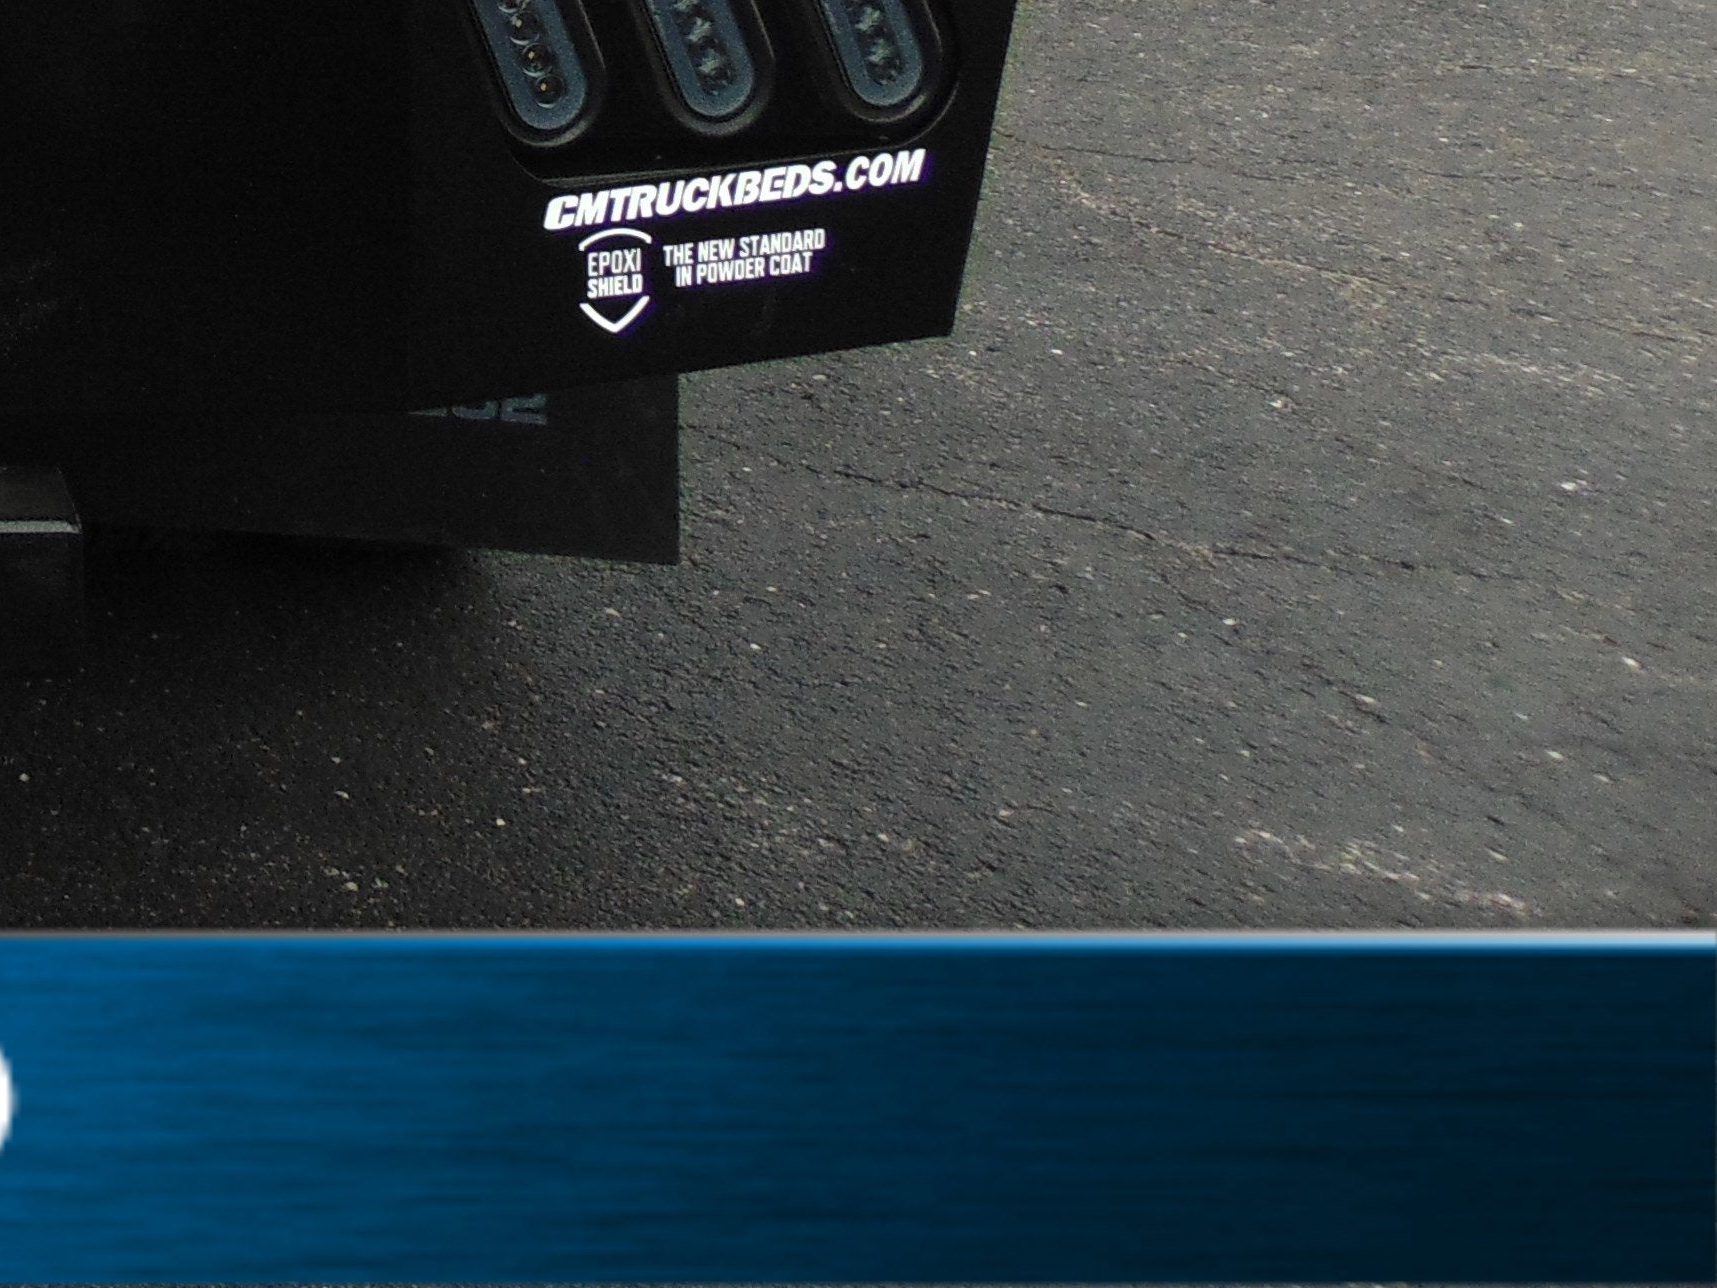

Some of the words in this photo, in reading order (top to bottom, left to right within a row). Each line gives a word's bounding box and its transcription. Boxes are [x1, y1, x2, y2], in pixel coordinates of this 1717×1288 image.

[543, 148, 927, 231] CMTRUCKBEDS.COM
[587, 247, 642, 277] EPOXI
[663, 242, 694, 267] THE
[697, 238, 735, 263] NEW
[739, 228, 826, 258] STANDARD
[587, 273, 643, 299] SHIELD
[675, 264, 692, 288] IN
[696, 256, 765, 286] POWDER
[769, 250, 814, 277] COAT
